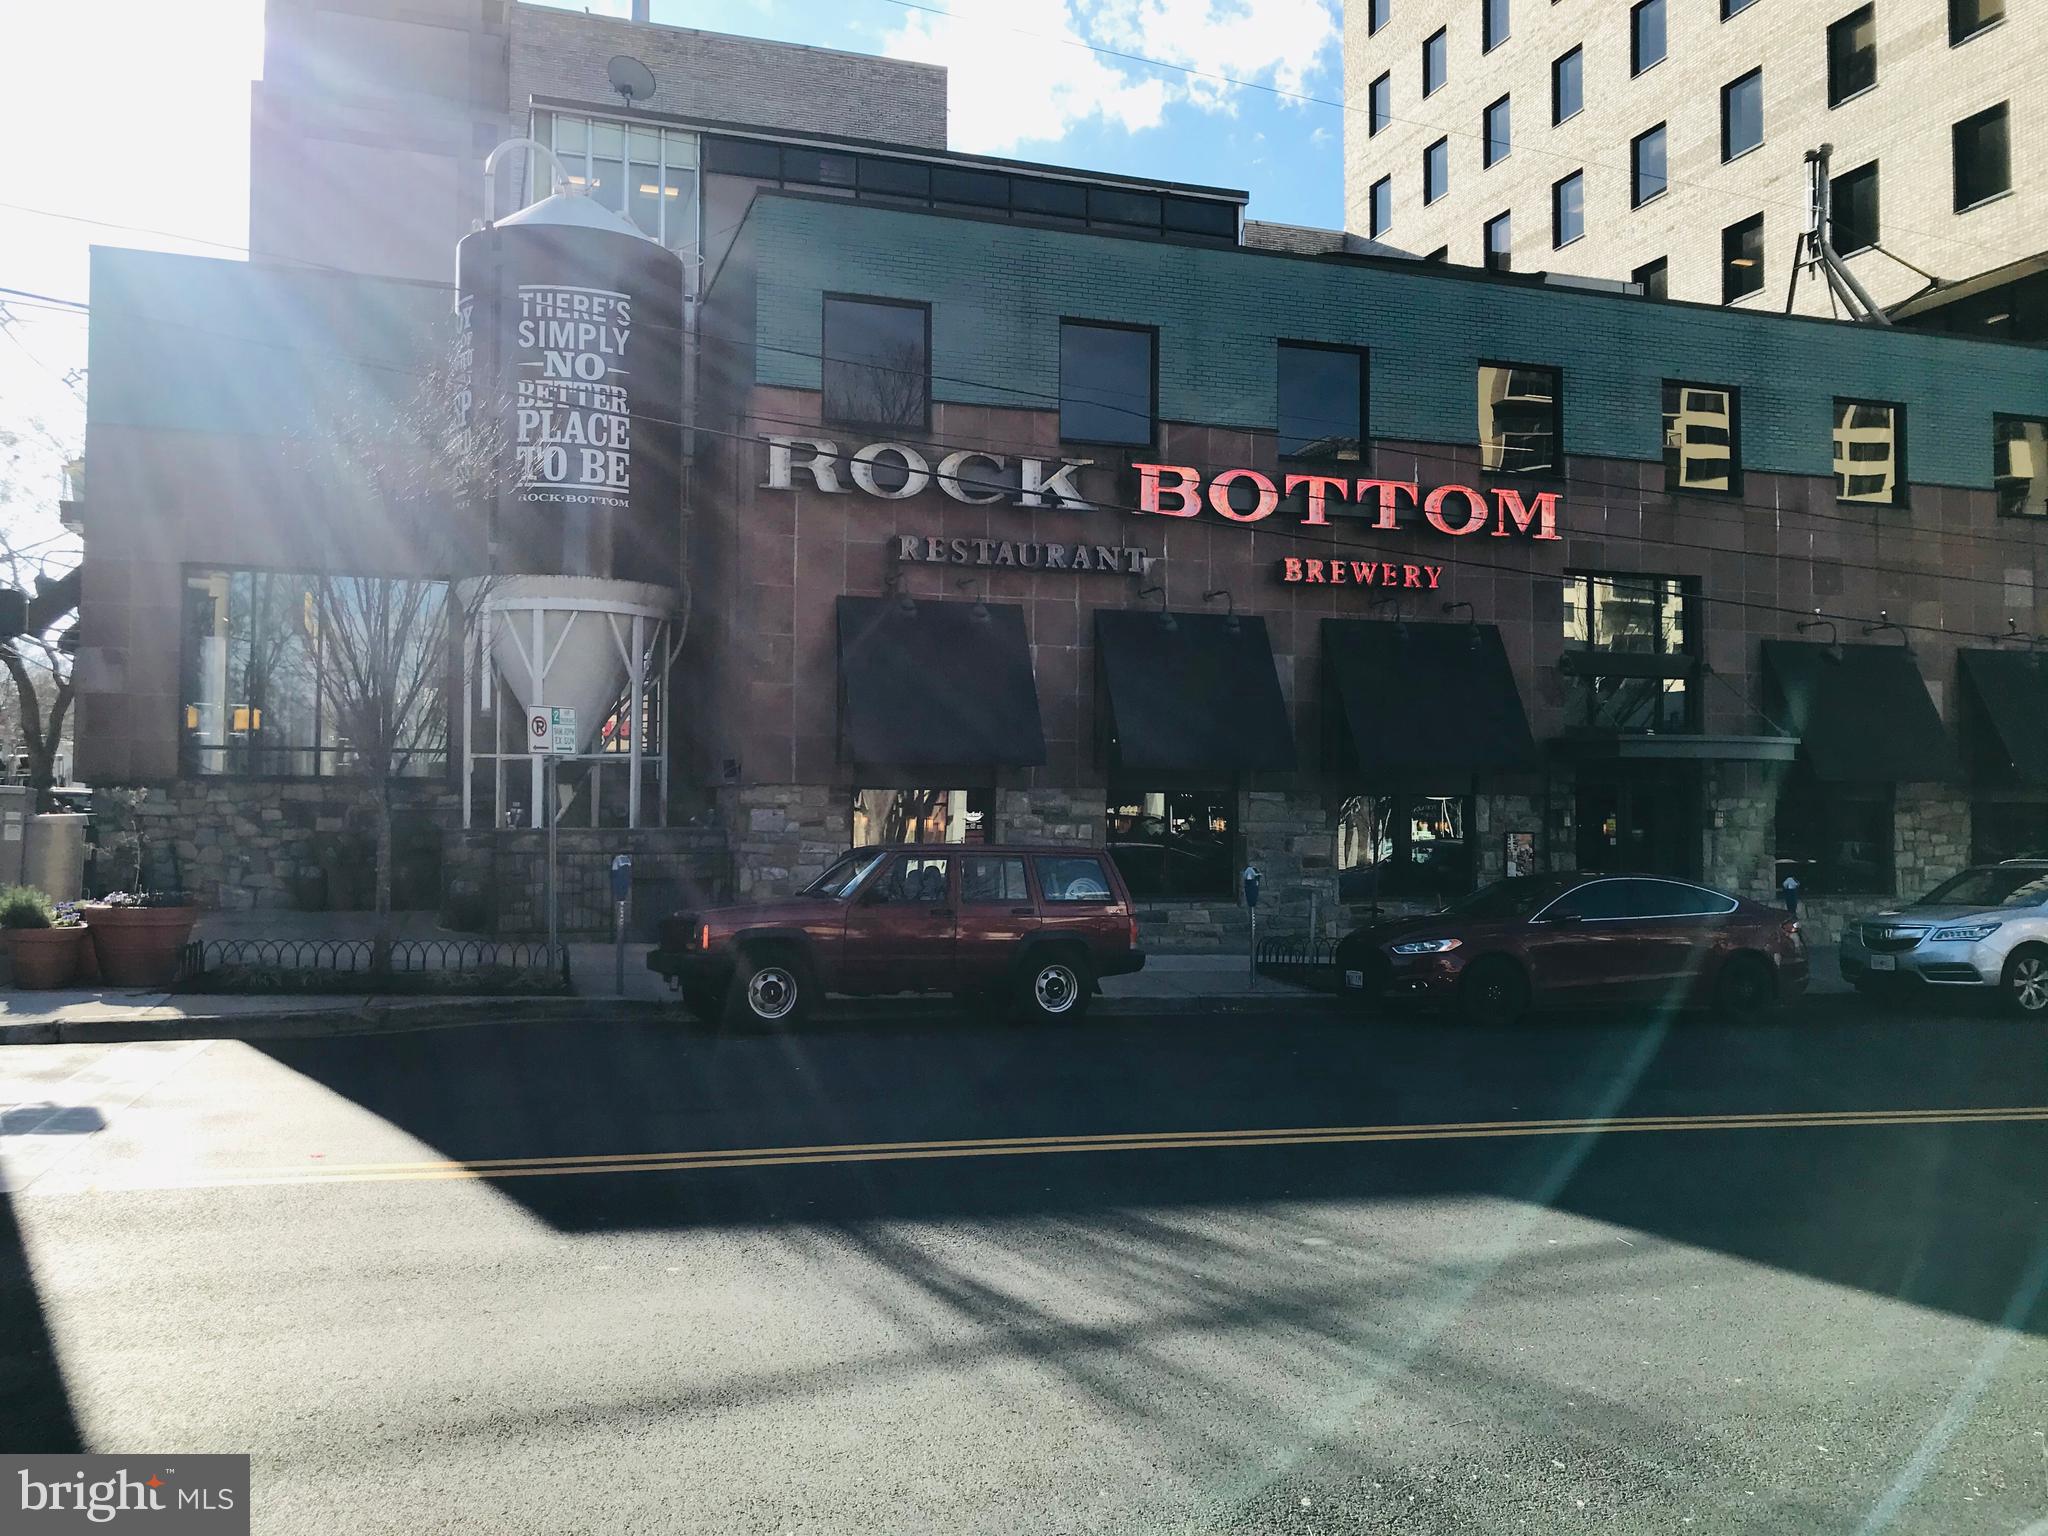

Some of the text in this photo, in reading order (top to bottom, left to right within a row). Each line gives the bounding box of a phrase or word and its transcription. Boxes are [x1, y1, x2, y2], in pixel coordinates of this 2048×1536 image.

[518, 292, 631, 326] THERE'S
[518, 320, 631, 356] SIMPLY
[543, 350, 606, 381] NO
[517, 380, 630, 415] BETTER
[517, 410, 630, 450] PLACE
[516, 446, 630, 488] TO BE
[758, 432, 1564, 541] ROCK BOTTOM
[899, 535, 1148, 574] RESTAURANT
[1283, 557, 1445, 589] BREWERY
